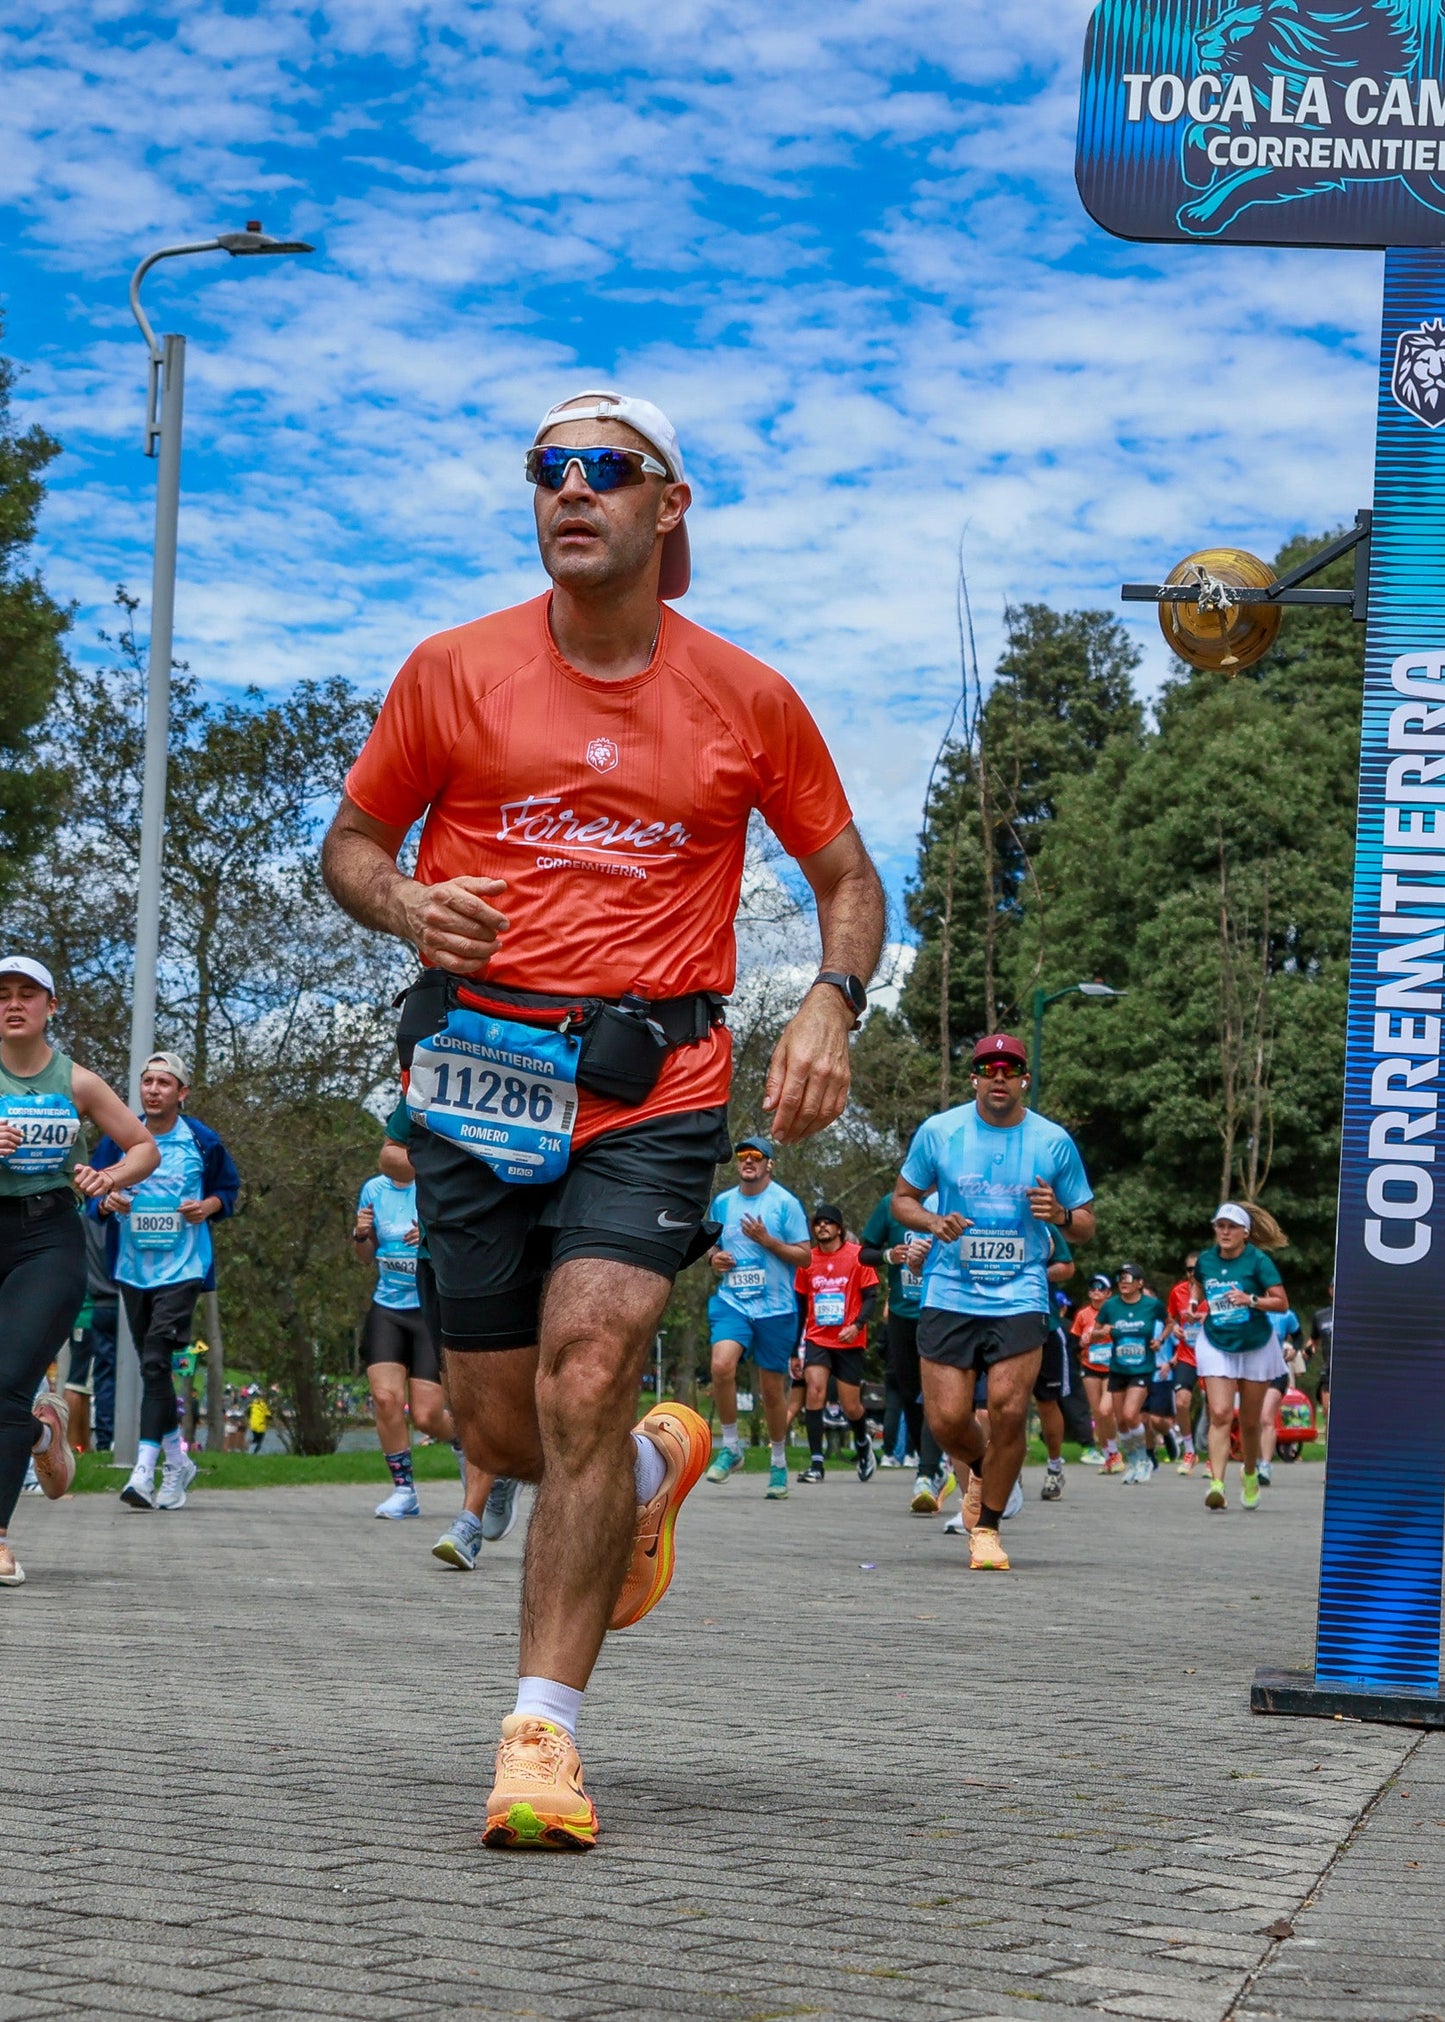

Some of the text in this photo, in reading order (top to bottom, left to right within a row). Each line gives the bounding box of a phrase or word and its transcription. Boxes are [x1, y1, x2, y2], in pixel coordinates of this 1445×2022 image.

[1122, 73, 1256, 123] TOCA
[1270, 75, 1332, 125] LA
[496, 795, 692, 848] Forever
[536, 856, 648, 880] CORREMITIERRA
[432, 1033, 555, 1076] CORREMITIERRA
[430, 1062, 553, 1123] 11286
[460, 1124, 561, 1153] ROMERO 21K
[137, 1216, 174, 1231] 18029
[970, 1241, 1015, 1260] 11729
